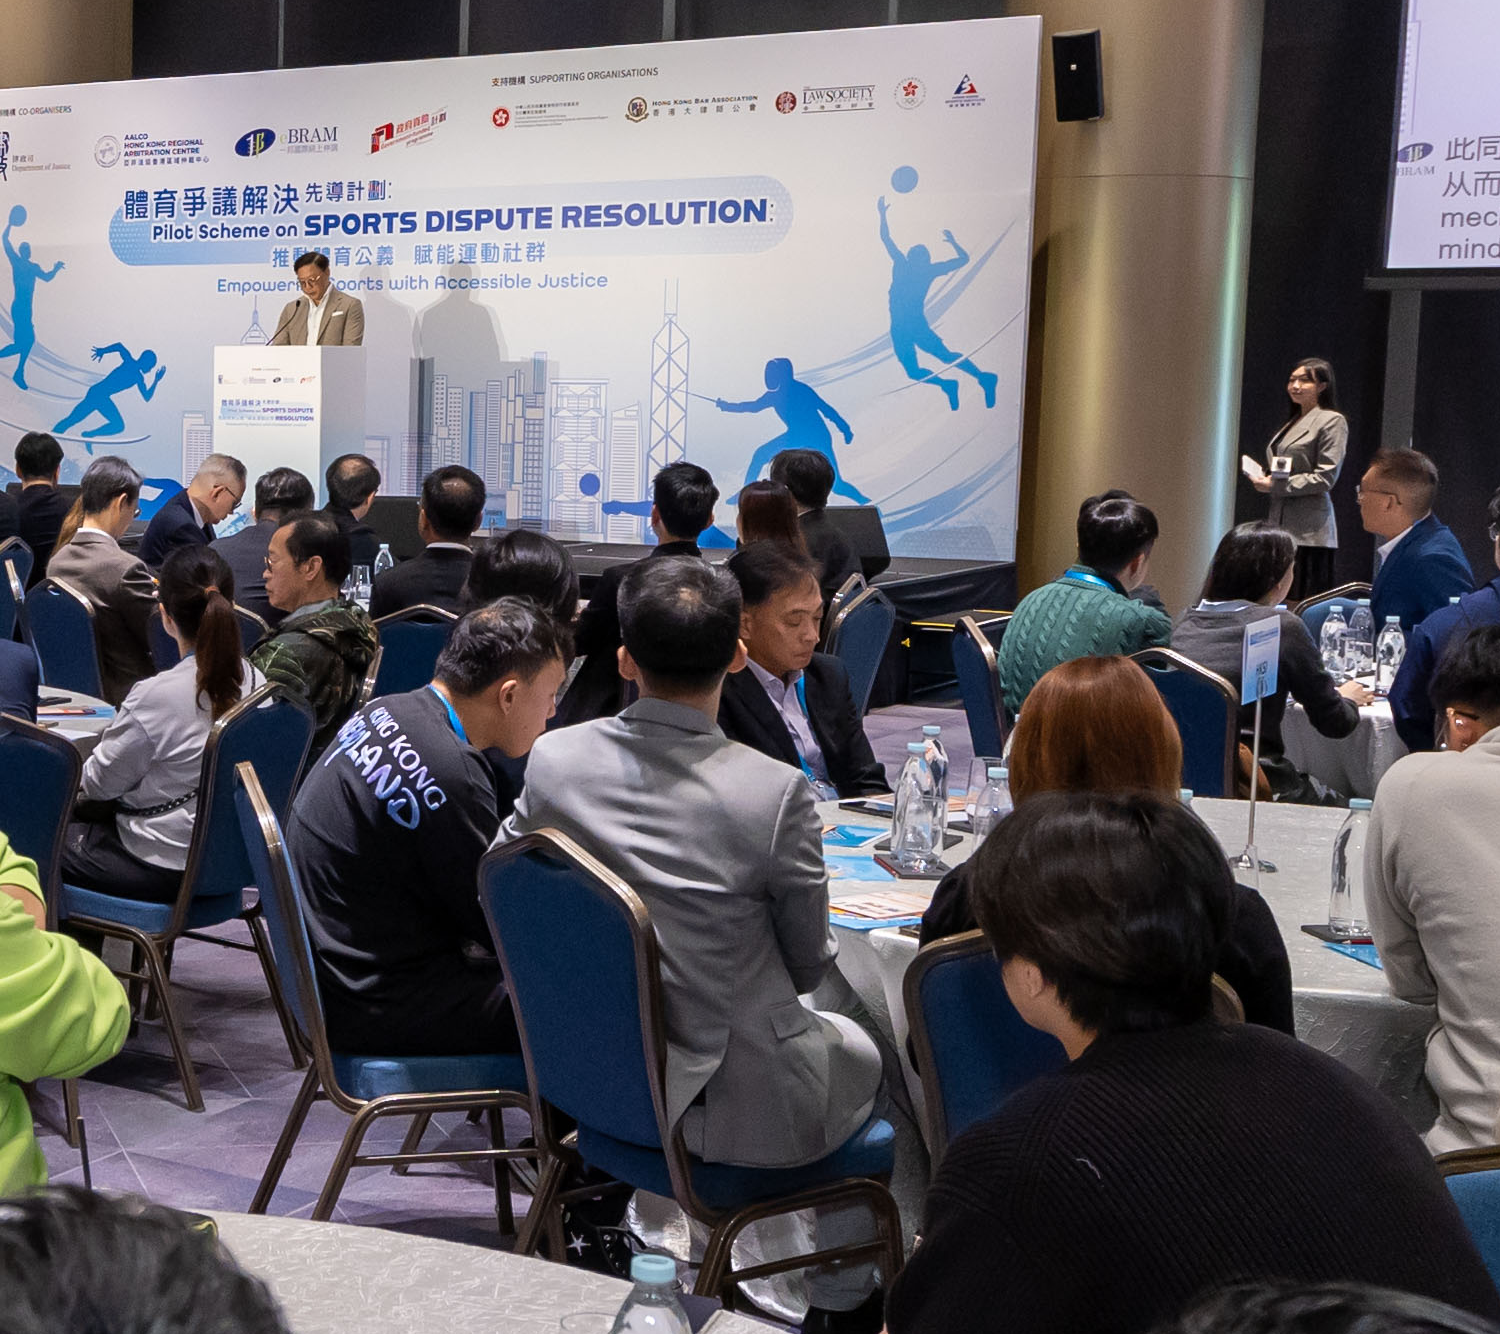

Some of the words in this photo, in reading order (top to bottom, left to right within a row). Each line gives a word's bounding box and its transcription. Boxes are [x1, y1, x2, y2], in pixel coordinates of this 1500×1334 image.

[528, 71, 586, 86] SUPPORTING
[586, 66, 660, 82] ORGANISATIONS
[17, 104, 73, 117] CO-ORGANISERS
[123, 133, 149, 142] AALCO
[123, 141, 145, 150] HONG
[146, 140, 167, 149] KONG
[167, 138, 205, 148] REGIONAL
[279, 125, 339, 146] eBRAM
[123, 148, 171, 158] ARBITRATION
[172, 147, 201, 156] CENTRE
[124, 182, 300, 221] 體育爭議解決
[152, 222, 194, 242] Pilot
[198, 221, 271, 241] Scheme
[275, 224, 298, 238] on
[303, 210, 418, 238] SPORTS
[425, 206, 554, 234] DISPUTE
[561, 197, 775, 229] RESOLUTION:
[413, 240, 547, 267] 賦能運動社群
[389, 273, 431, 291] with
[433, 271, 533, 291] Accessible
[537, 270, 609, 290] Justice
[388, 734, 448, 811] KONG
